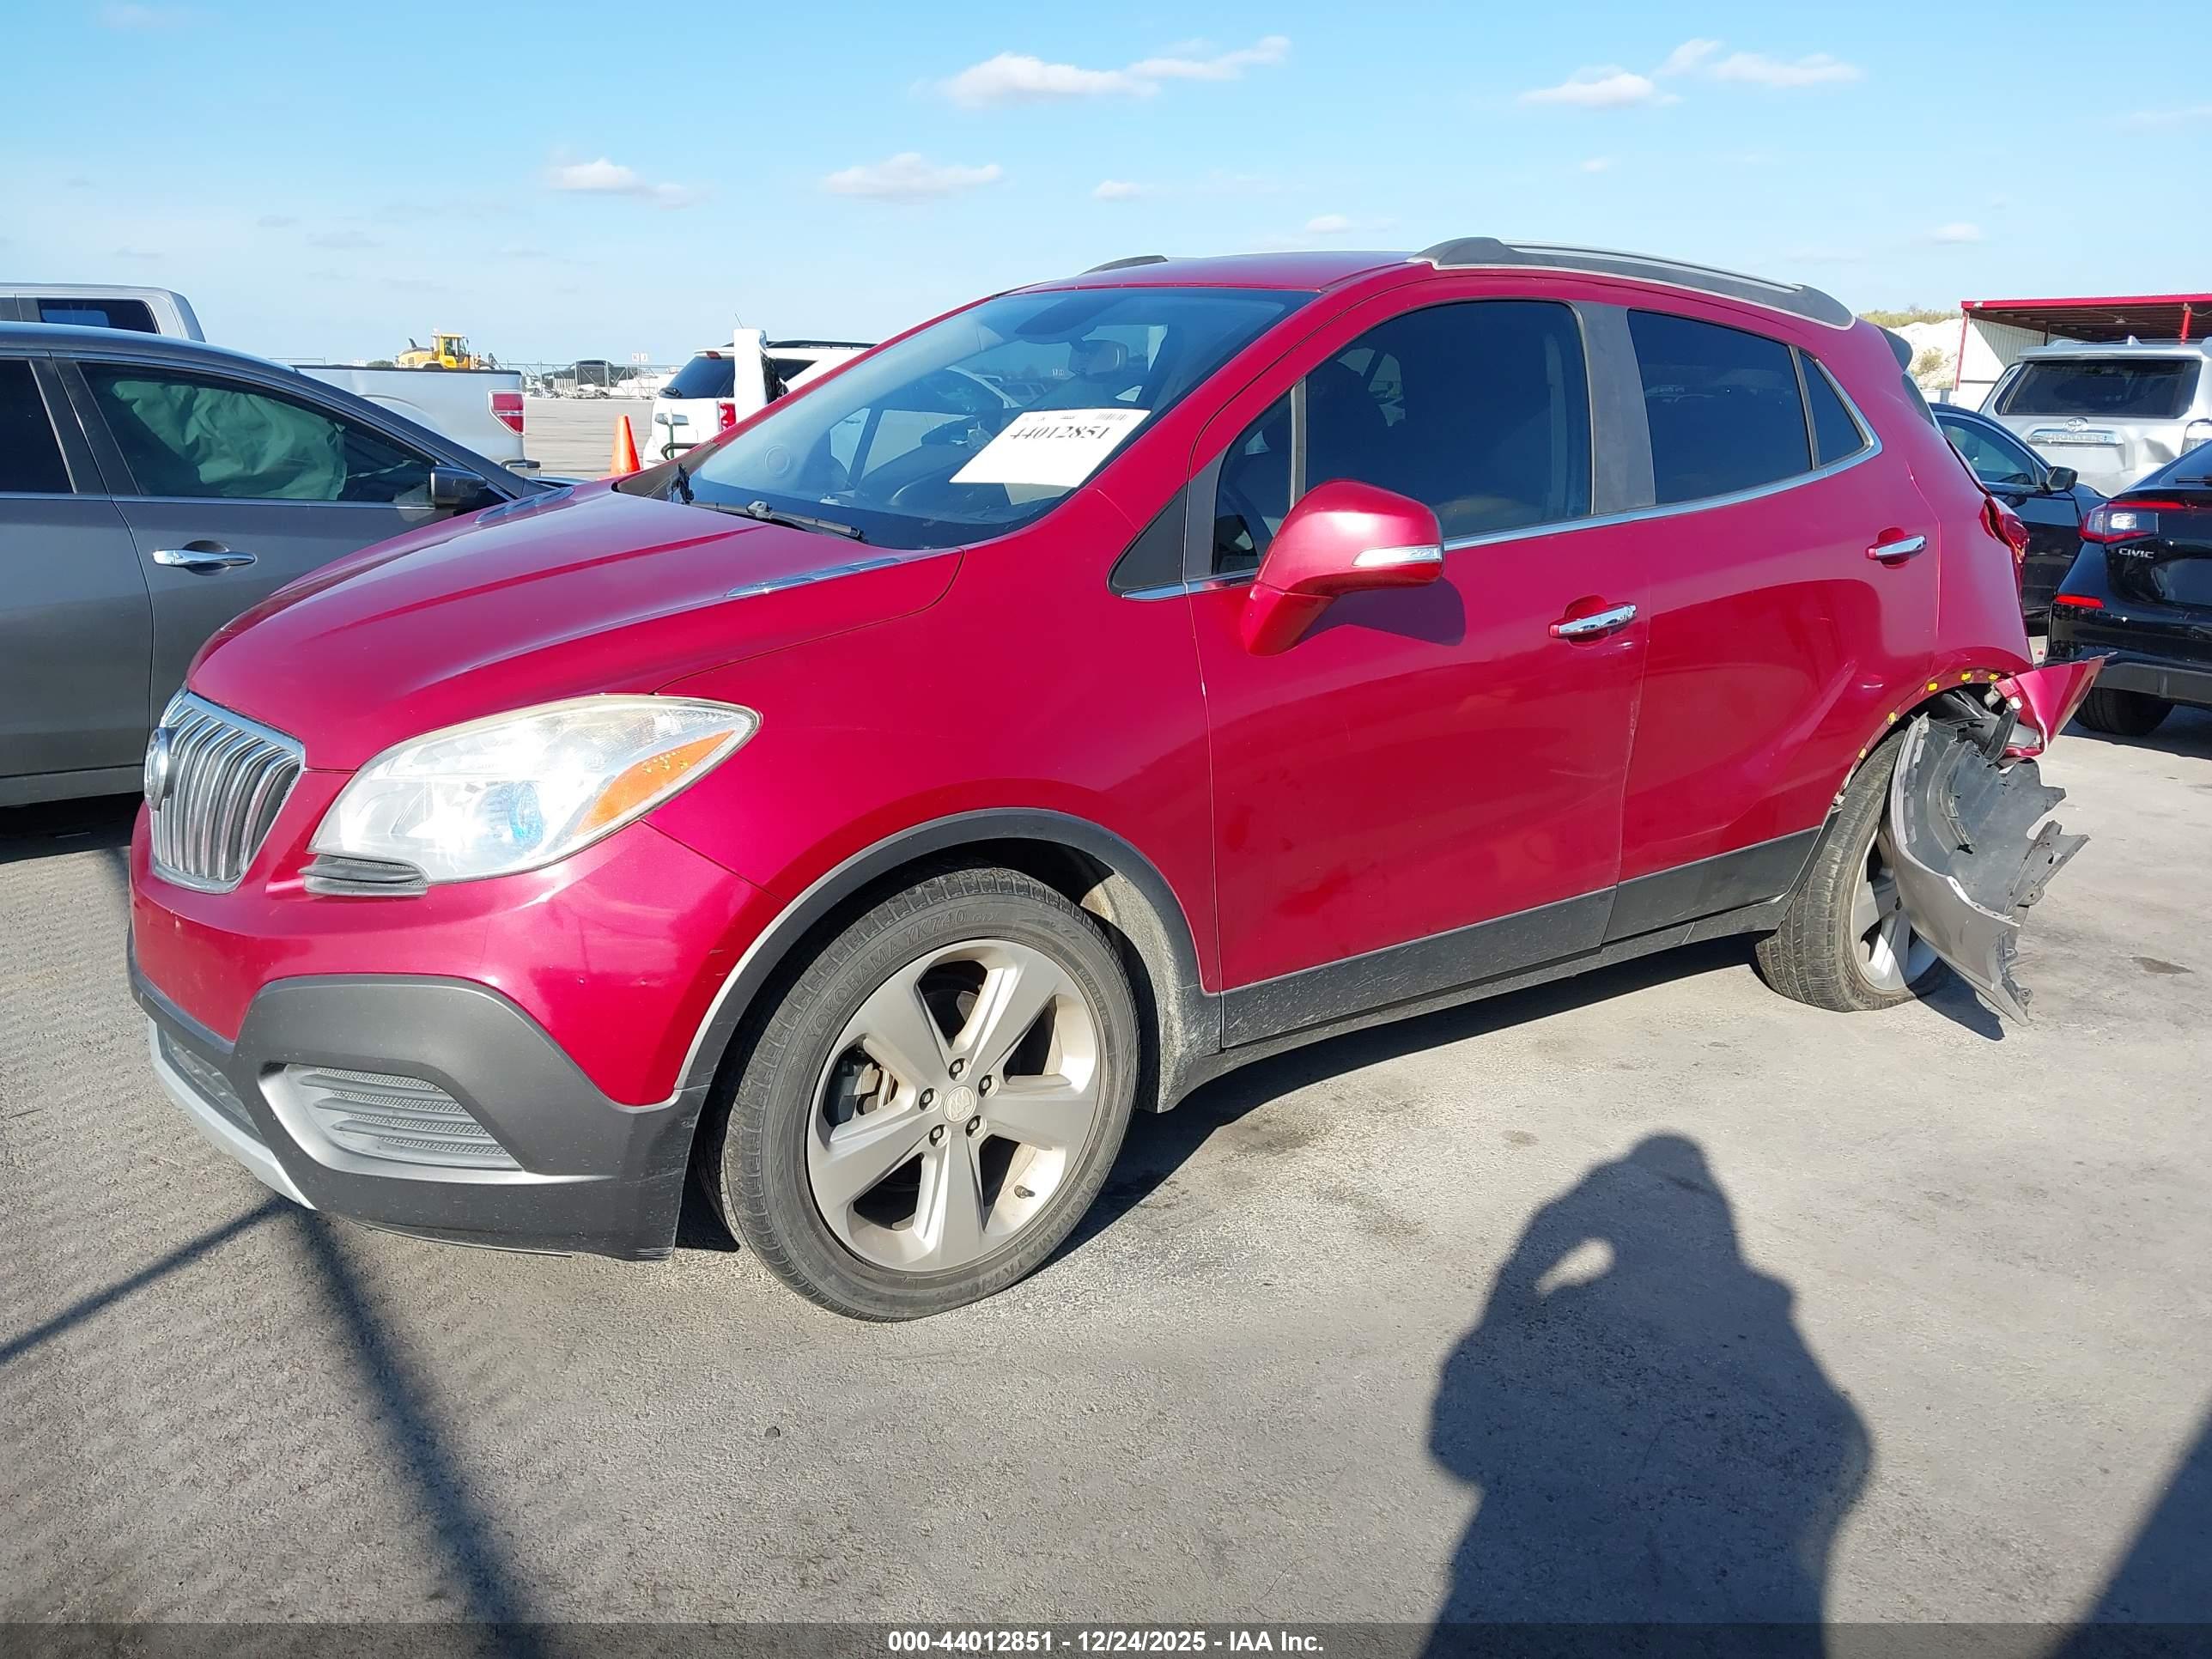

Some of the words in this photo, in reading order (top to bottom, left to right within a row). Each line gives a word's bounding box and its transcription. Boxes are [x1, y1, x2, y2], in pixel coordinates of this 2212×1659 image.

[1009, 425, 1110, 440] 44012851
[2118, 548, 2154, 559] CIVIC
[805, 939, 902, 1039] YOKOHAMA
[906, 908, 967, 946] YK740
[1027, 1165, 1105, 1259] YOKOHAMA
